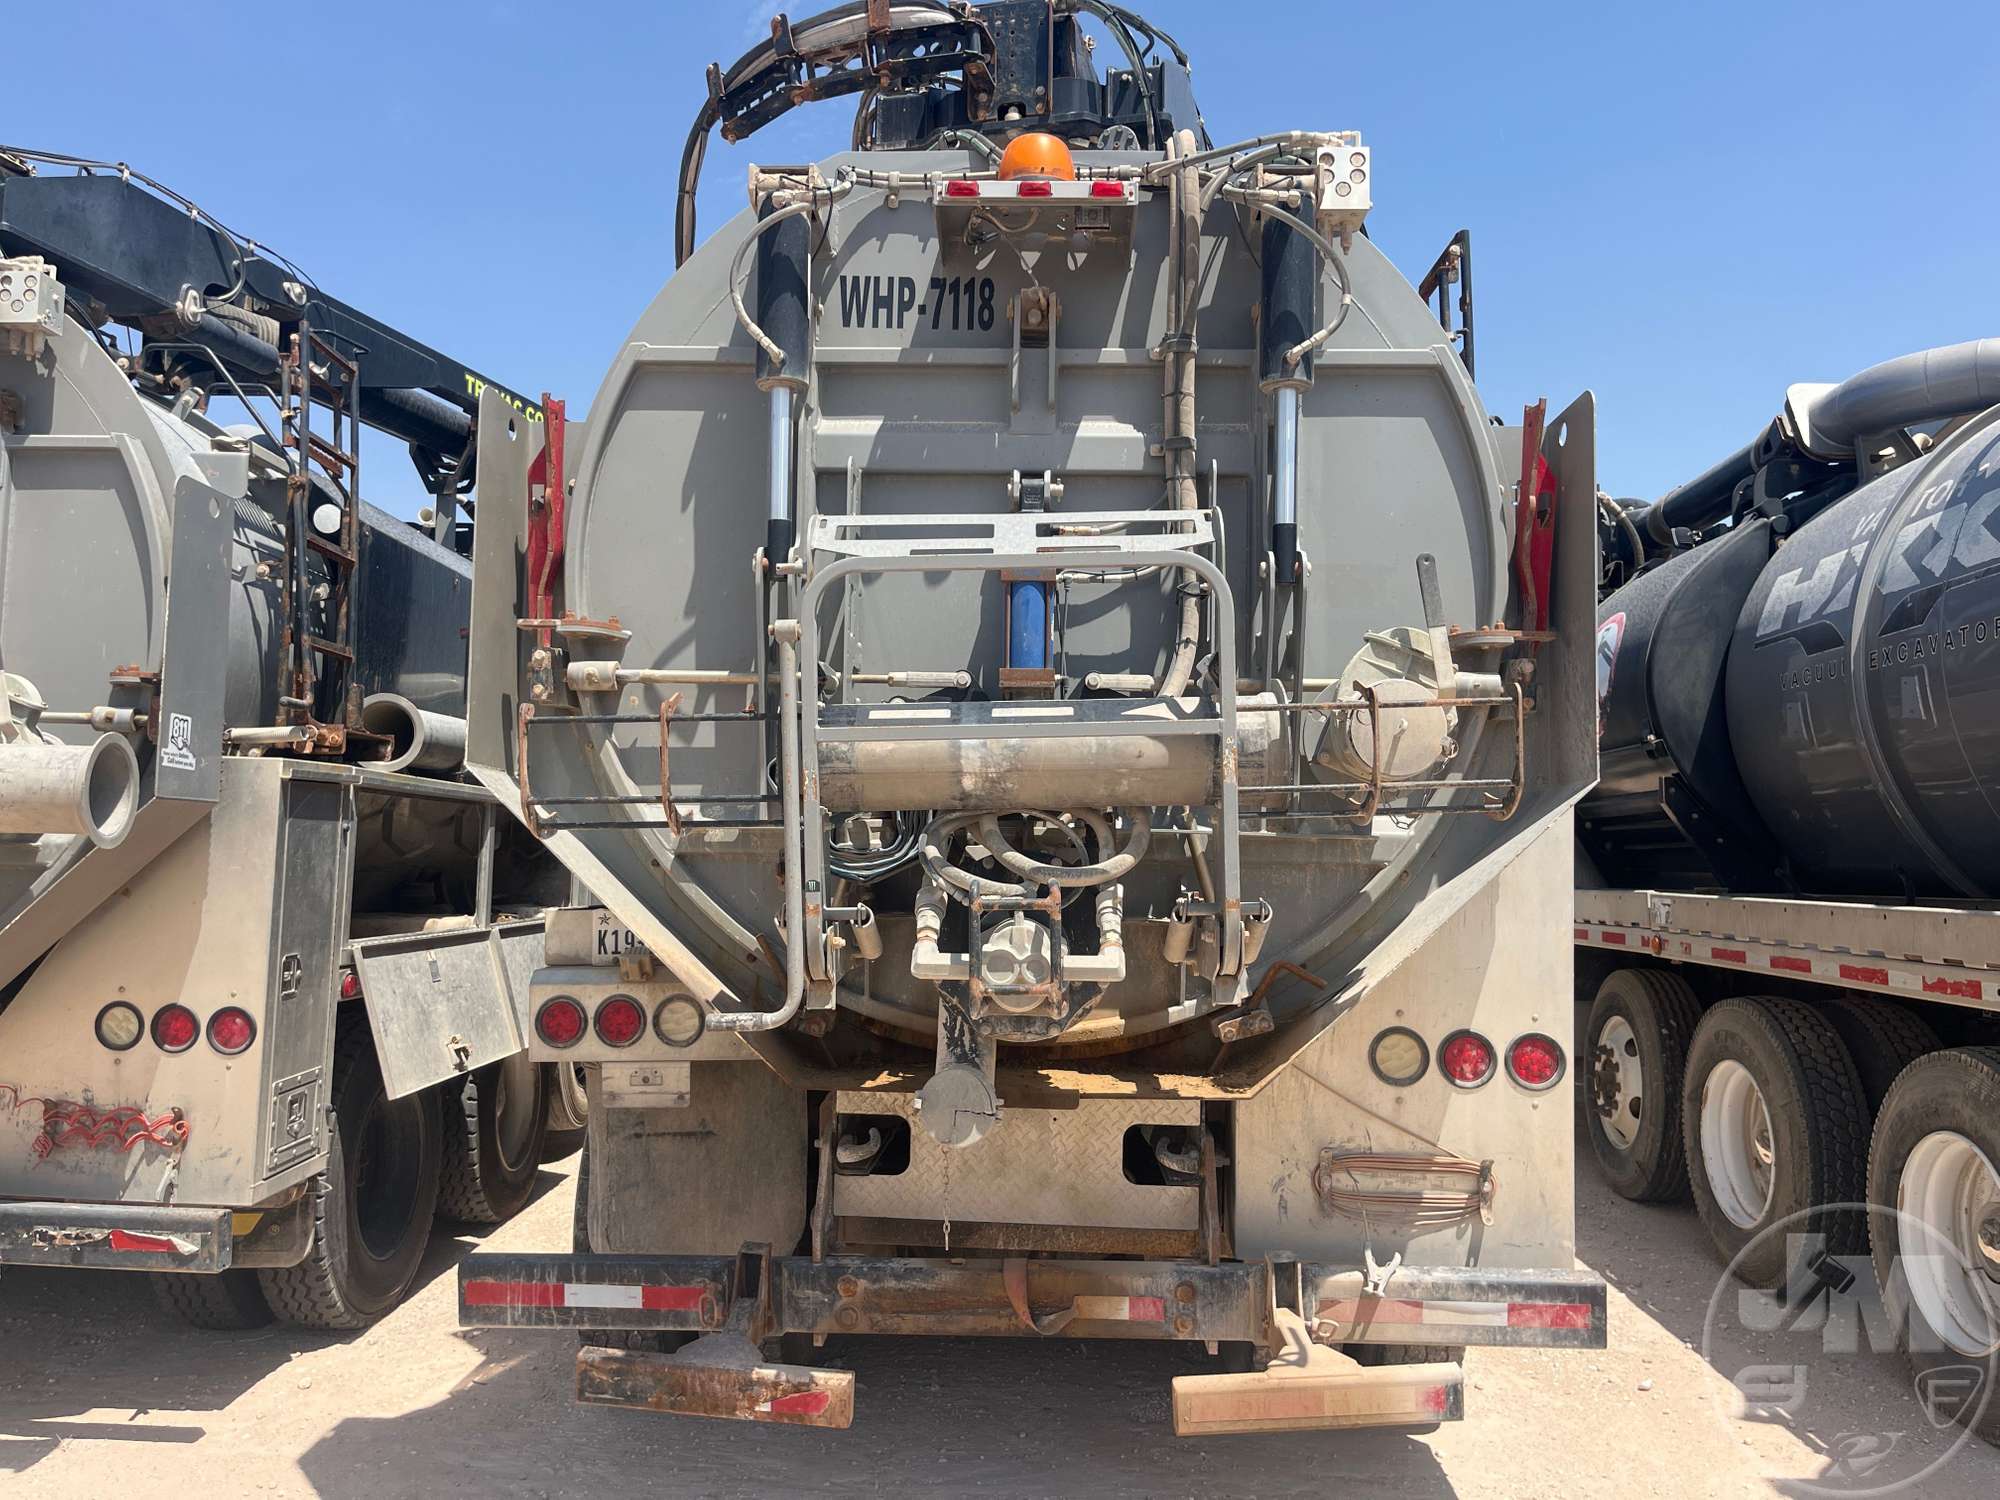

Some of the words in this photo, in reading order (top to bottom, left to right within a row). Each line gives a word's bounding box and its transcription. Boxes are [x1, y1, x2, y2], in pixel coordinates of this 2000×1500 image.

[839, 274, 995, 332] WHP-7118
[1851, 467, 1977, 541] VATOR
[173, 717, 189, 739] 811
[597, 929, 645, 955] K19
